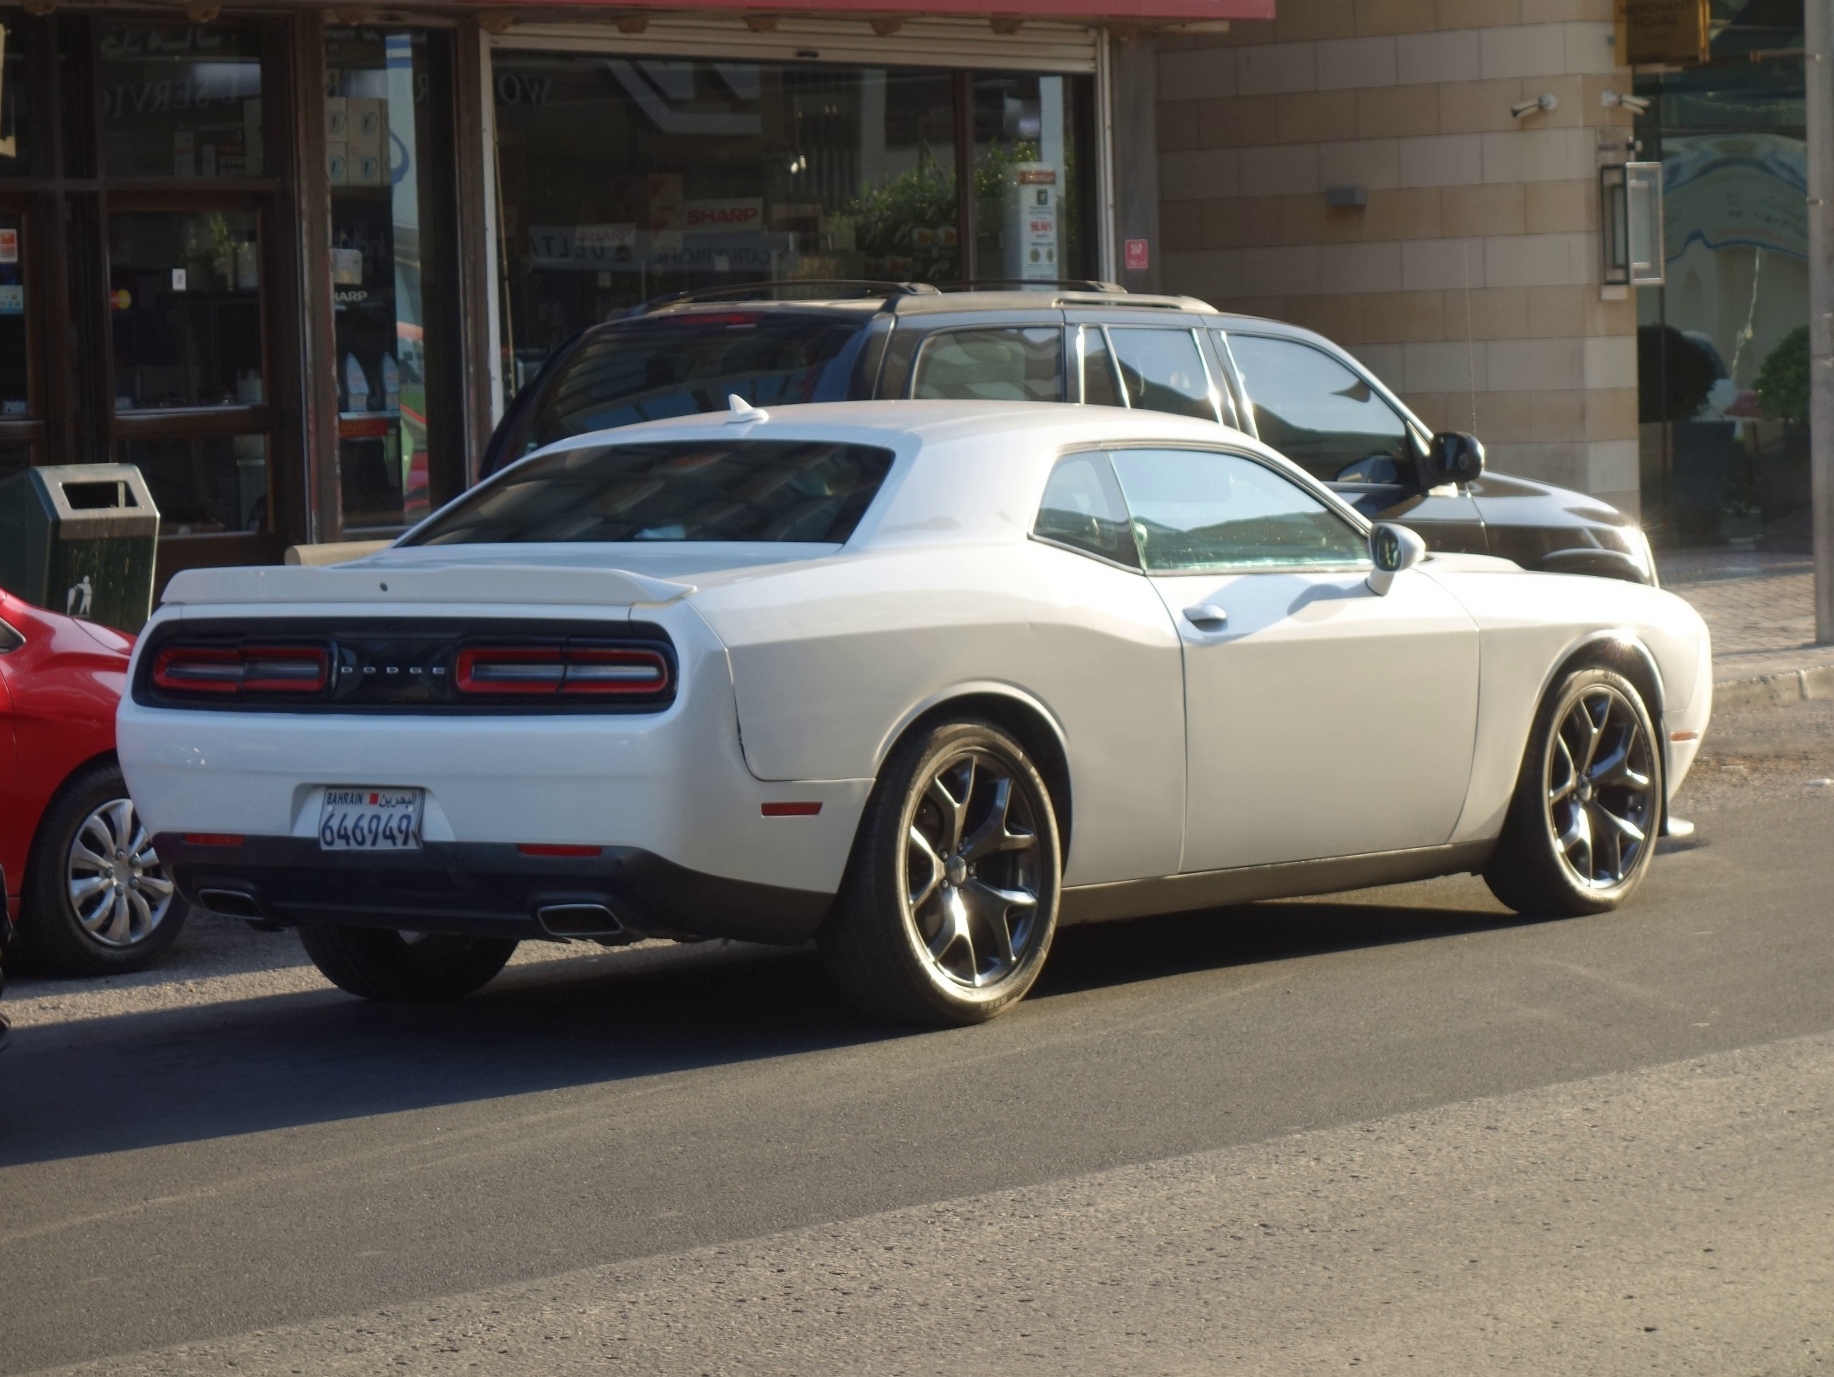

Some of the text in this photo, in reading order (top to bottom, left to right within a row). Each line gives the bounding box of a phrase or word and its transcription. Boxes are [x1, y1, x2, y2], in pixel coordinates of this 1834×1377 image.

[1632, 14, 1679, 27] HOUSE
[687, 207, 757, 224] SHARP
[333, 290, 368, 301] HARP
[341, 666, 446, 674] DODGE
[326, 792, 363, 805] BAHRAIN
[379, 792, 417, 808] البحرين
[321, 813, 412, 847] 646949
